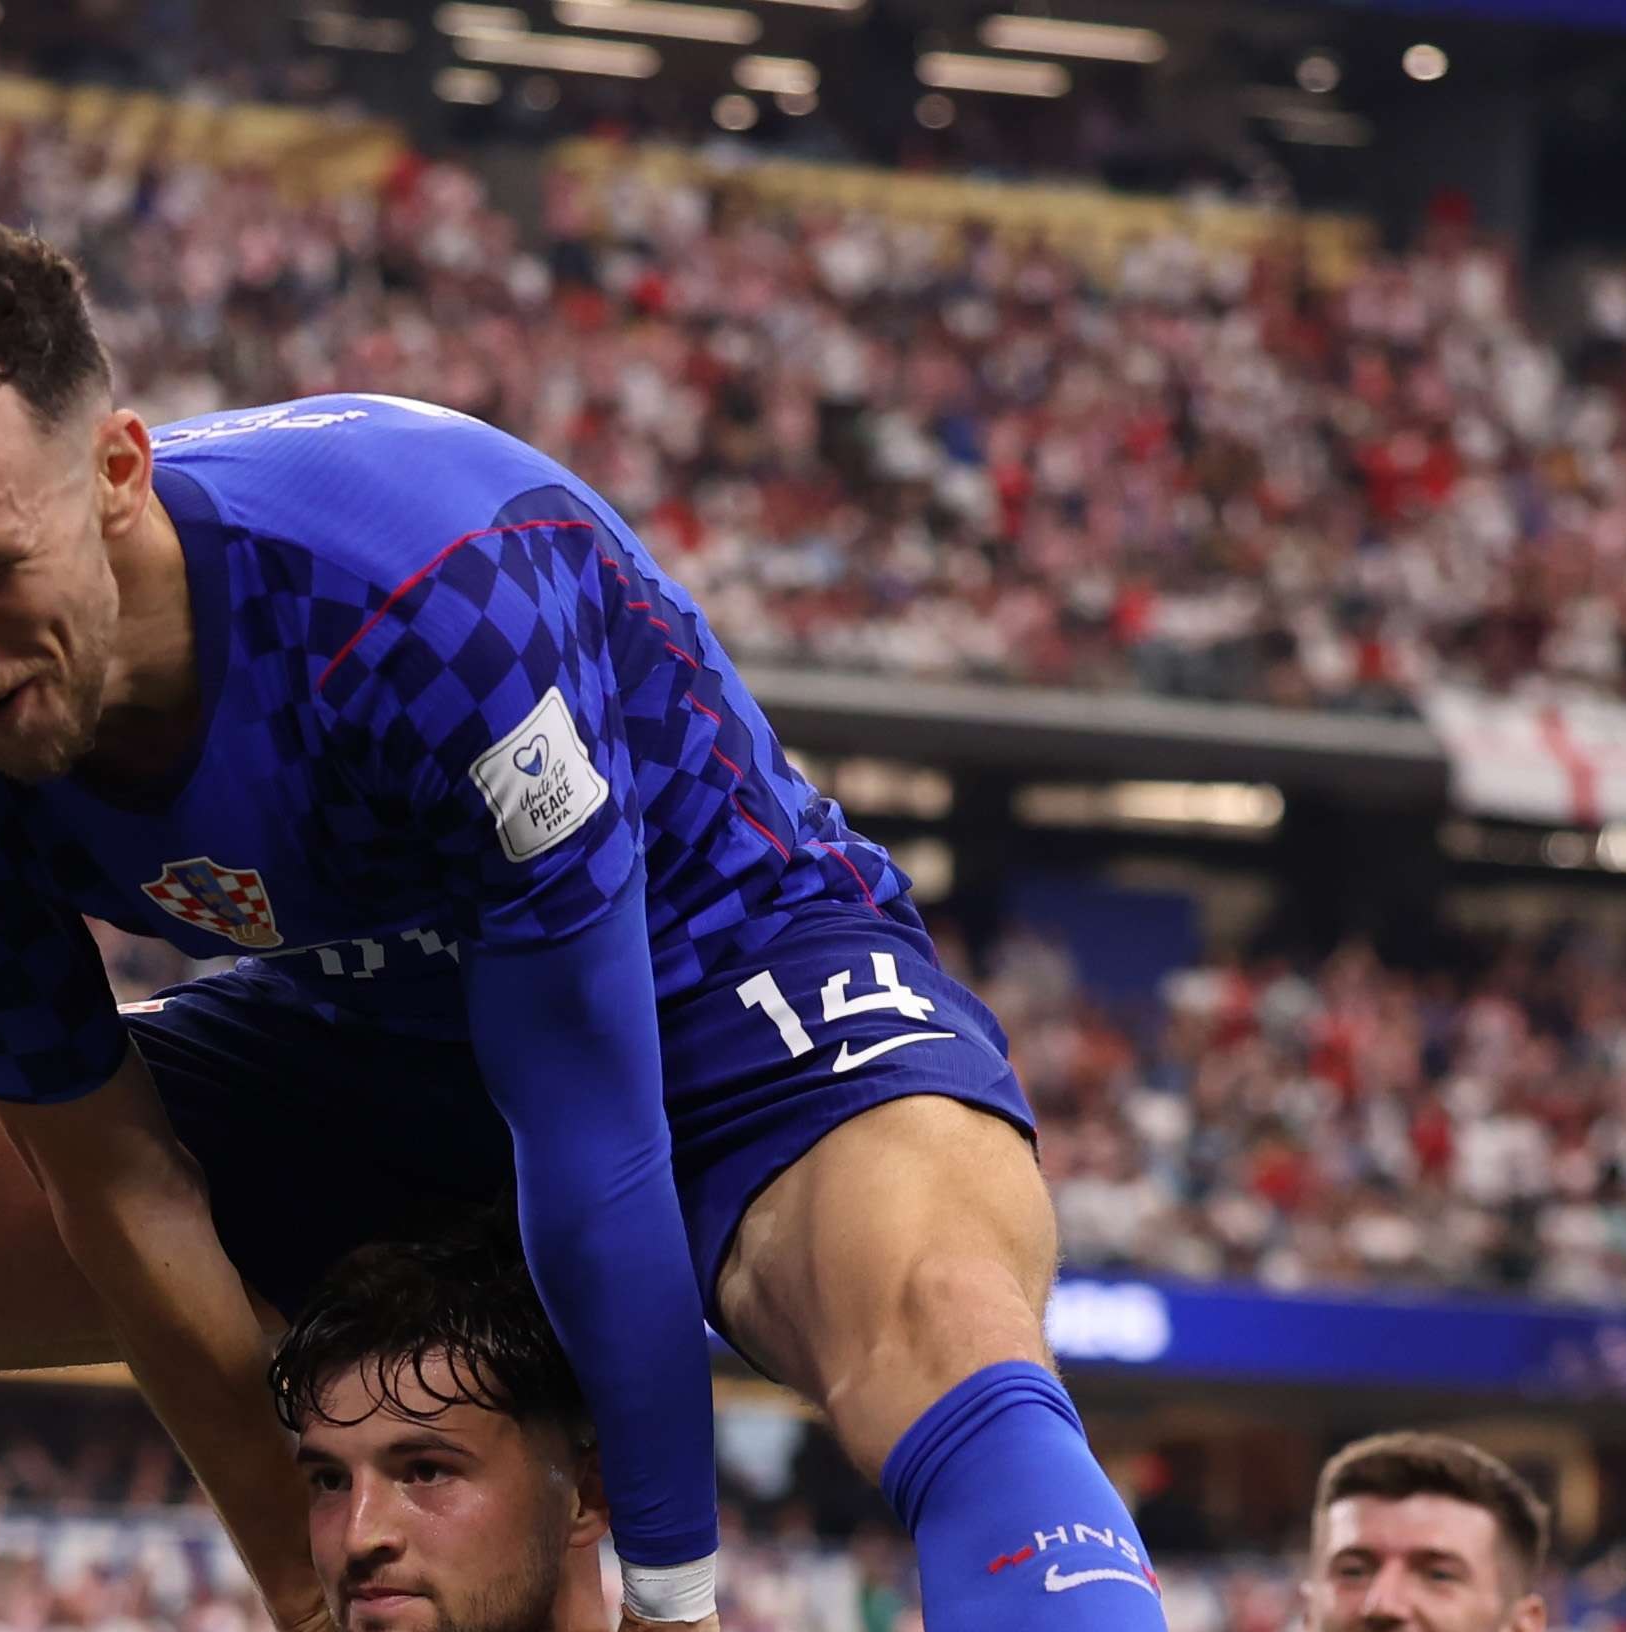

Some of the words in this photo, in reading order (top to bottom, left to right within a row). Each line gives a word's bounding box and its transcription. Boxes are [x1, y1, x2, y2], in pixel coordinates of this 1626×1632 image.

[520, 778, 551, 812] Unite
[529, 779, 574, 828] PEACE
[545, 808, 572, 832] FIFA
[735, 951, 936, 1058] 14
[1033, 1523, 1141, 1566] HNS
